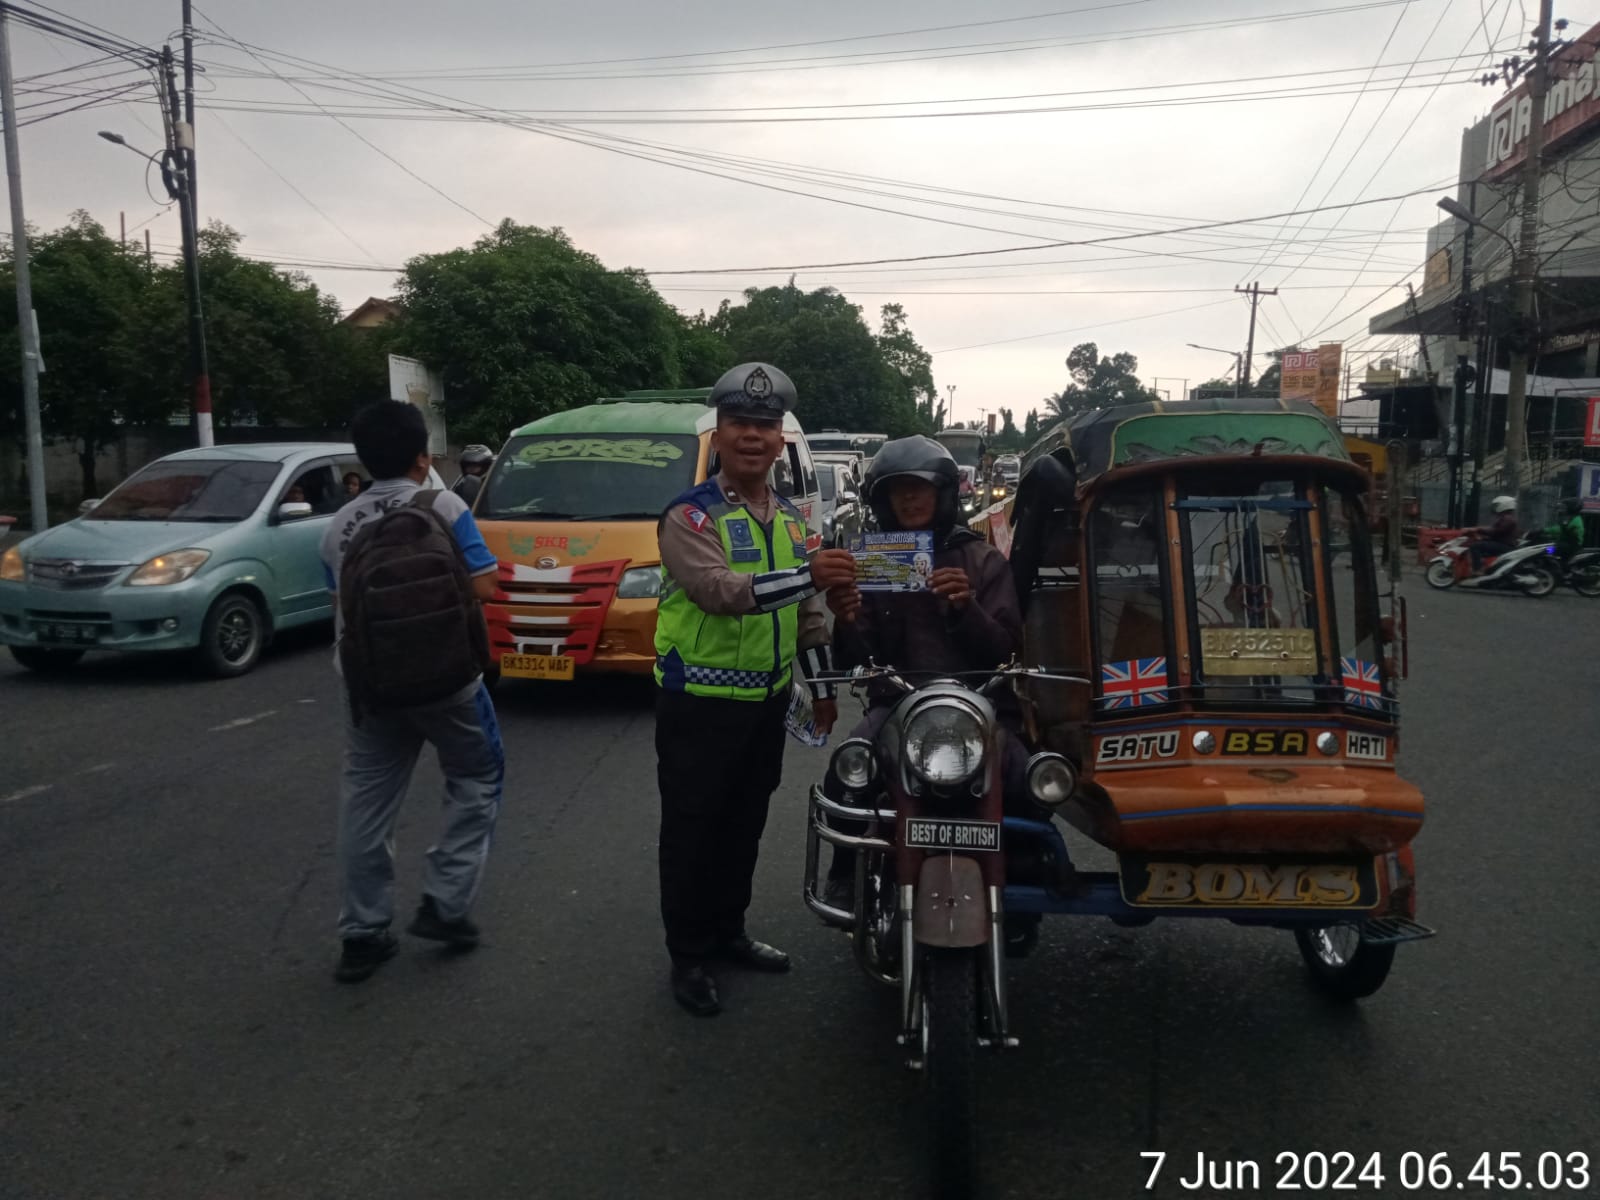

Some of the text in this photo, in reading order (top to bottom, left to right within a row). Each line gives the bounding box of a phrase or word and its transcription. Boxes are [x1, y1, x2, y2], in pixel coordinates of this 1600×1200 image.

[1101, 732, 1385, 759] SATU BSA HATI
[911, 823, 995, 846] BEST OF BRITISH
